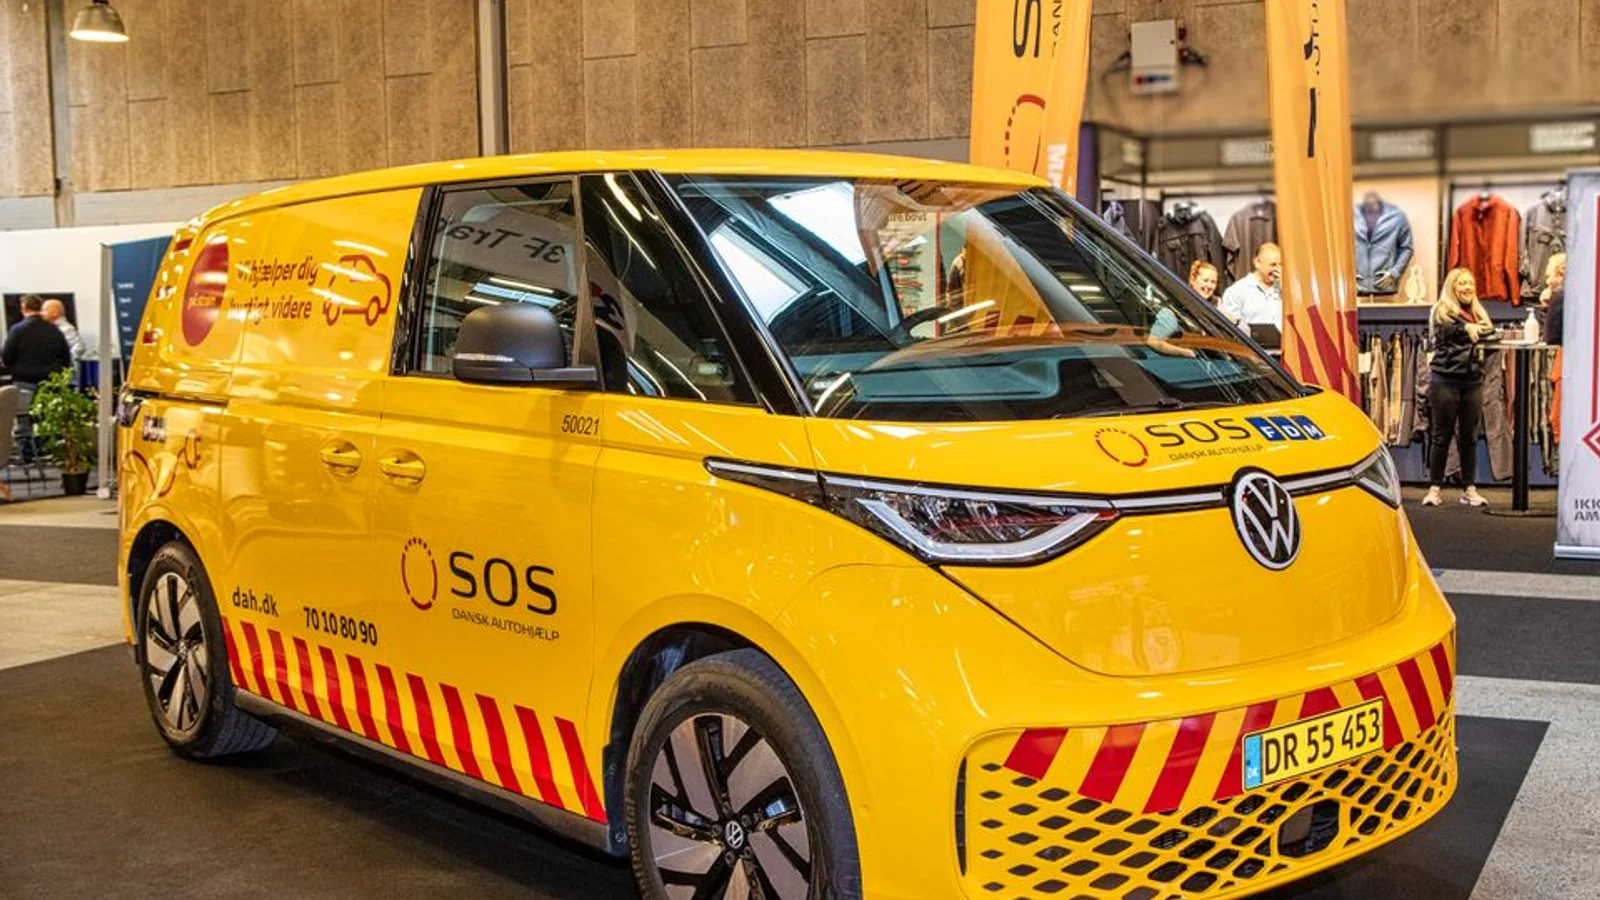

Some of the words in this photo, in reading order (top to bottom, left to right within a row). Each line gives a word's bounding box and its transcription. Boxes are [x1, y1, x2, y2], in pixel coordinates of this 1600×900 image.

[248, 257, 296, 288] hjælper
[297, 255, 318, 286] dig
[271, 294, 312, 319] videre
[561, 414, 600, 436] 50021
[1145, 418, 1252, 448] SOS
[1257, 421, 1325, 440] FDM
[1168, 448, 1207, 461] DANSK
[449, 551, 558, 616] SOS
[231, 586, 279, 618] dah.dk
[452, 607, 490, 627] DANSK
[491, 616, 560, 641] AUTOHJÆLP
[1265, 732, 1299, 776] DR
[1307, 721, 1334, 763] 55
[1341, 708, 1380, 750] 453
